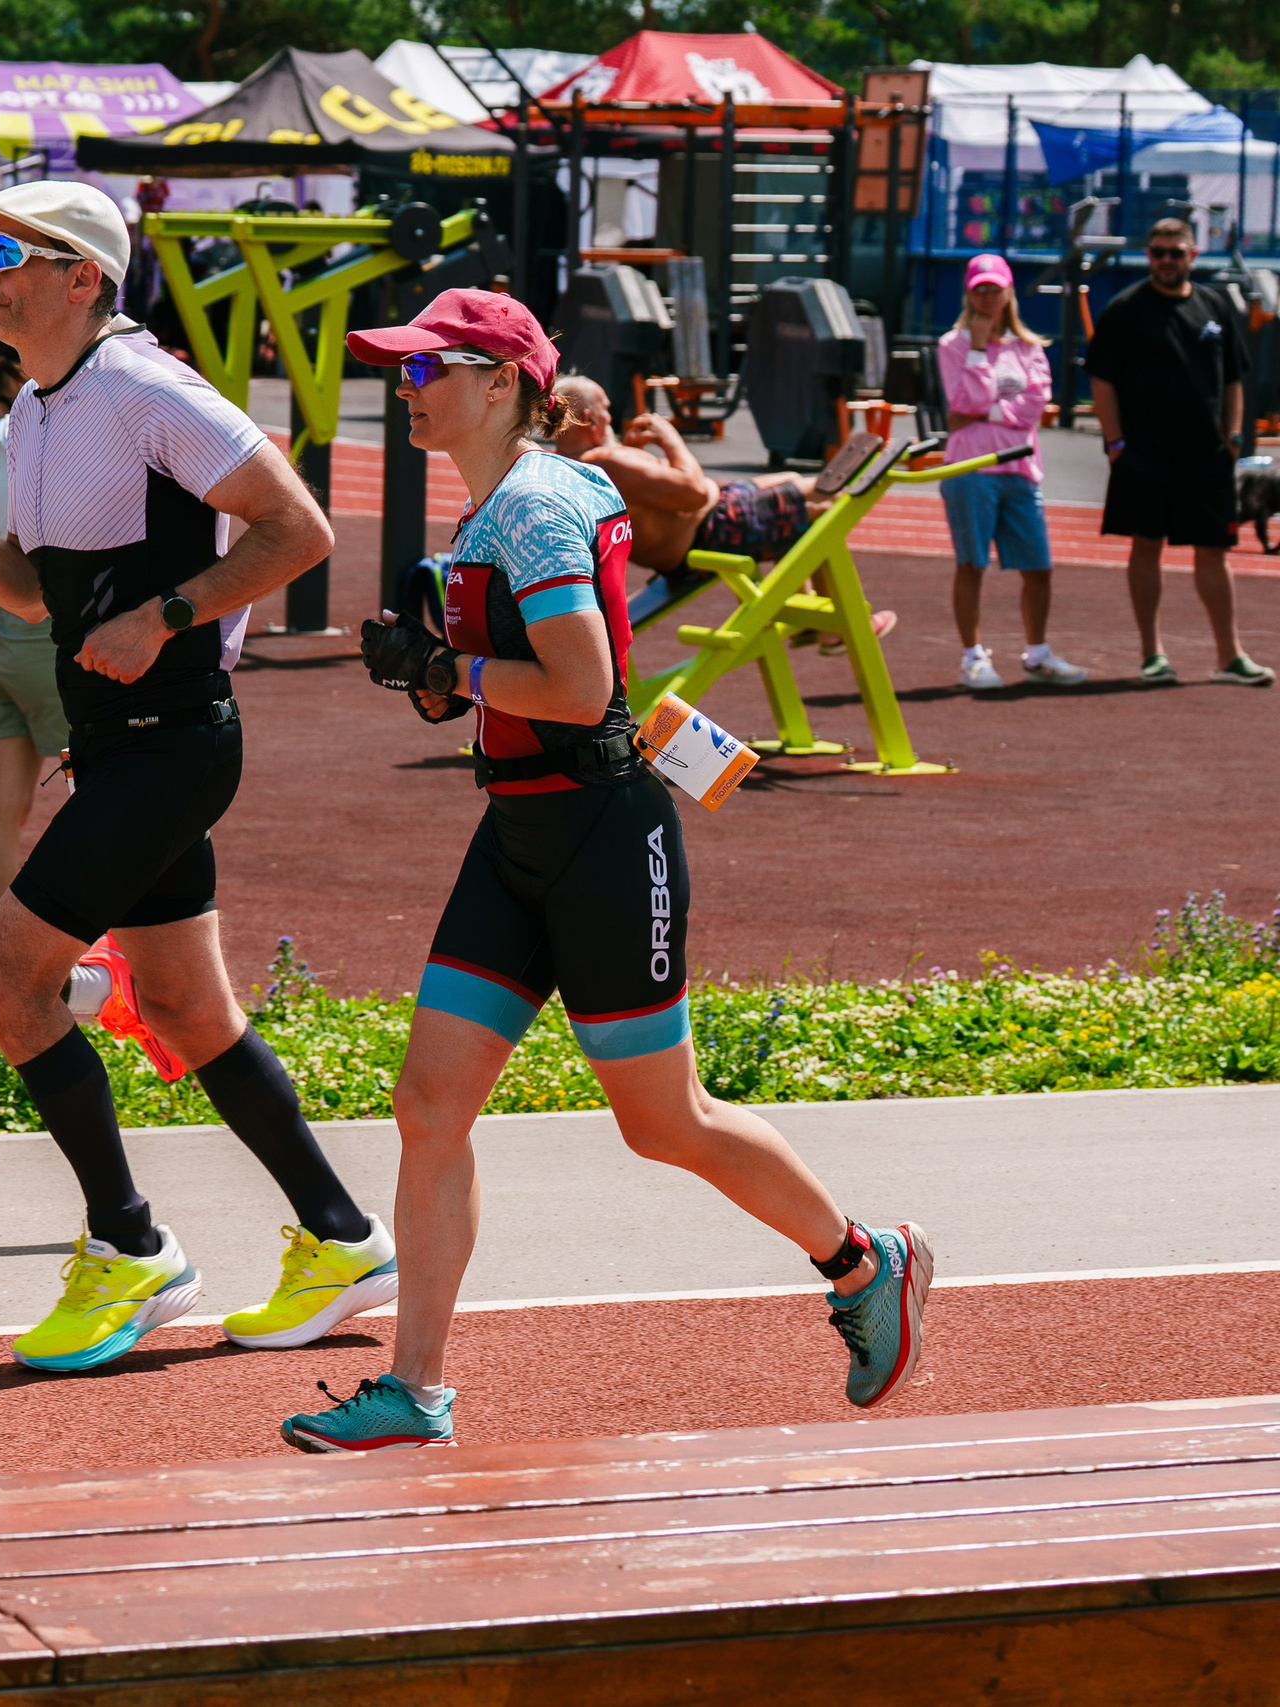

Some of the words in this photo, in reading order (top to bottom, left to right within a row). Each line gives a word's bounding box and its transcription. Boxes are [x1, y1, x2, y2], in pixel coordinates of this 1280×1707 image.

[14, 74, 159, 95] МАГАЗИН
[382, 679, 409, 688] NW
[691, 713, 728, 750] 2
[715, 762, 749, 802] ПОЛОВИНКА
[647, 824, 671, 982] ORBEA
[884, 1238, 904, 1279] HOKA
